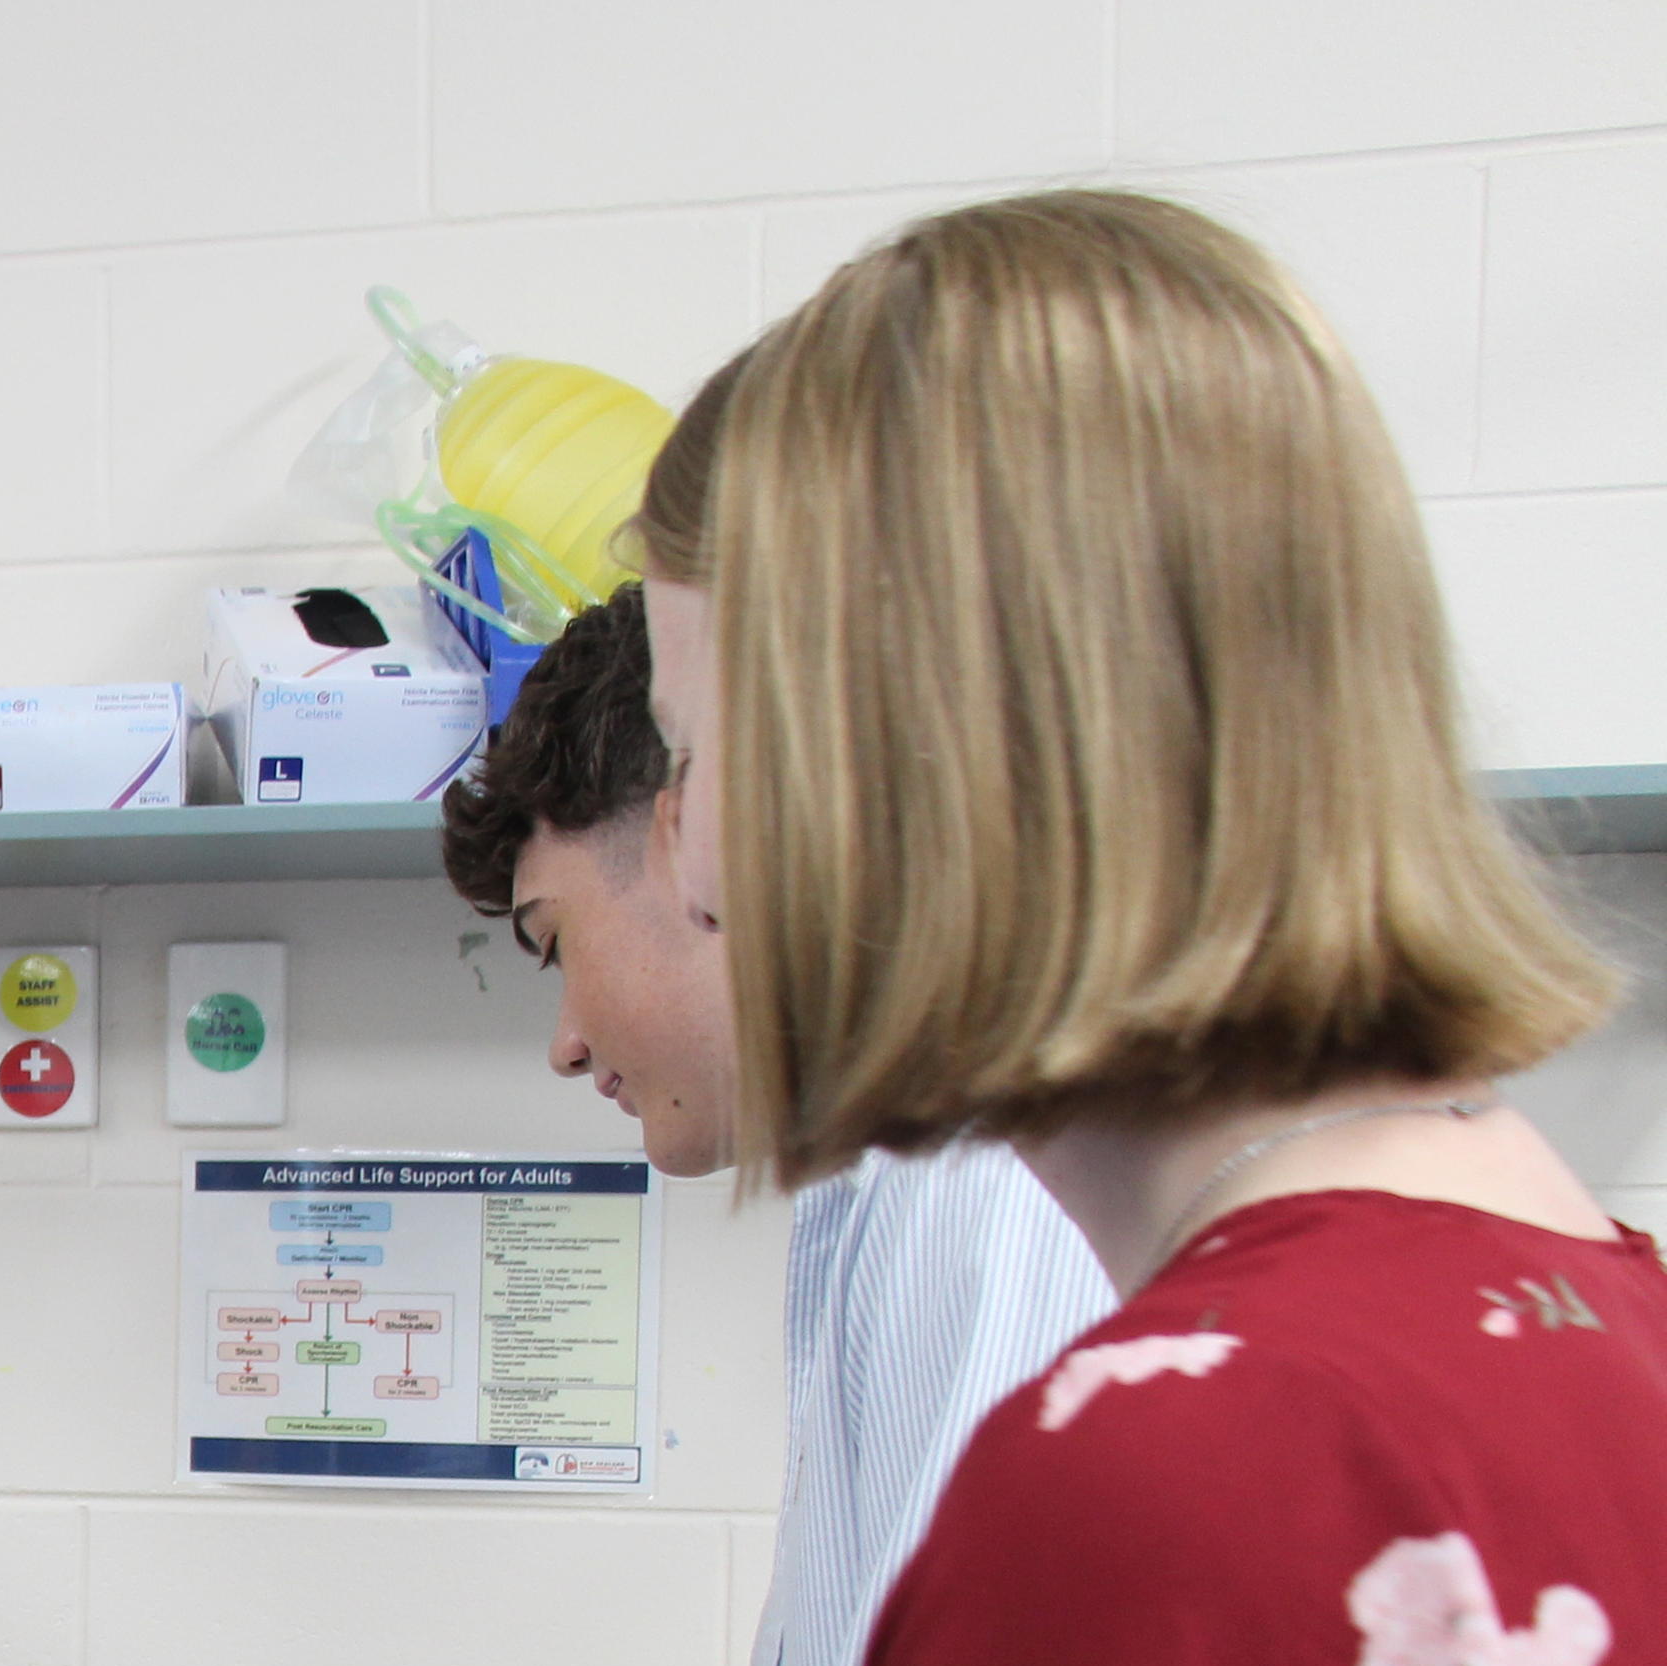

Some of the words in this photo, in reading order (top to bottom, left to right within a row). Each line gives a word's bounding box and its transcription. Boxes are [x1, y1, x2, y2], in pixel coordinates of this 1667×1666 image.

[295, 708, 343, 720] Celeste
[275, 760, 288, 779] L
[19, 980, 56, 991] STAFF
[16, 996, 60, 1007] ASSIST
[263, 1166, 355, 1184] Advanced
[360, 1167, 394, 1184] Life
[399, 1168, 474, 1187] Support
[480, 1168, 505, 1185] for
[509, 1169, 573, 1186] Adults
[308, 1203, 329, 1213] Start
[332, 1204, 353, 1213] CPR
[226, 1314, 273, 1325] Shockable
[399, 1312, 420, 1322] Non
[385, 1321, 434, 1331] Shockable
[235, 1347, 263, 1357] Shock
[238, 1376, 259, 1385] CPR
[397, 1379, 418, 1388] CPR
[355, 1424, 373, 1432] Care
